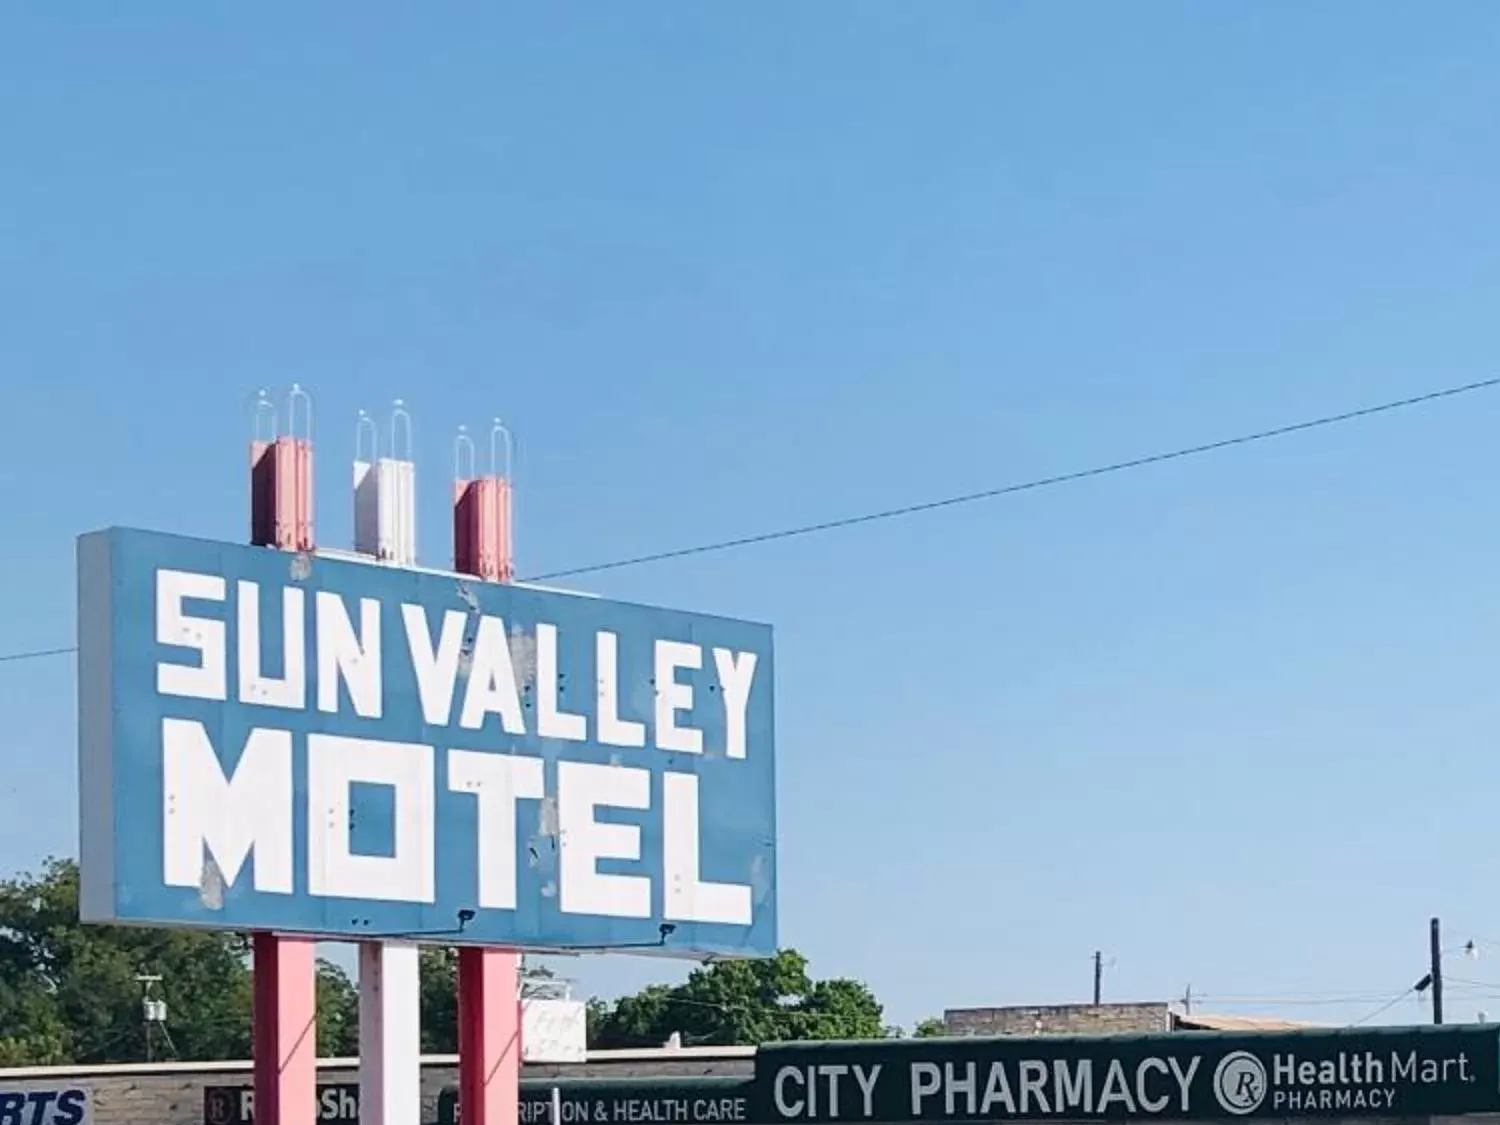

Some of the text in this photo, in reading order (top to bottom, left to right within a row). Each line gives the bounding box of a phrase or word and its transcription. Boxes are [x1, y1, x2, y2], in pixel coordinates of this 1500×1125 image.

[156, 568, 757, 758] SUN VALLEY
[161, 716, 752, 926] MOTEL
[774, 1056, 1202, 1118] CITY PHARMACY
[1273, 1051, 1383, 1085] Health
[594, 1101, 608, 1121] &
[614, 1099, 688, 1121] HEALTH
[693, 1098, 746, 1120] CARE
[1273, 1087, 1396, 1109] PHARMACY
